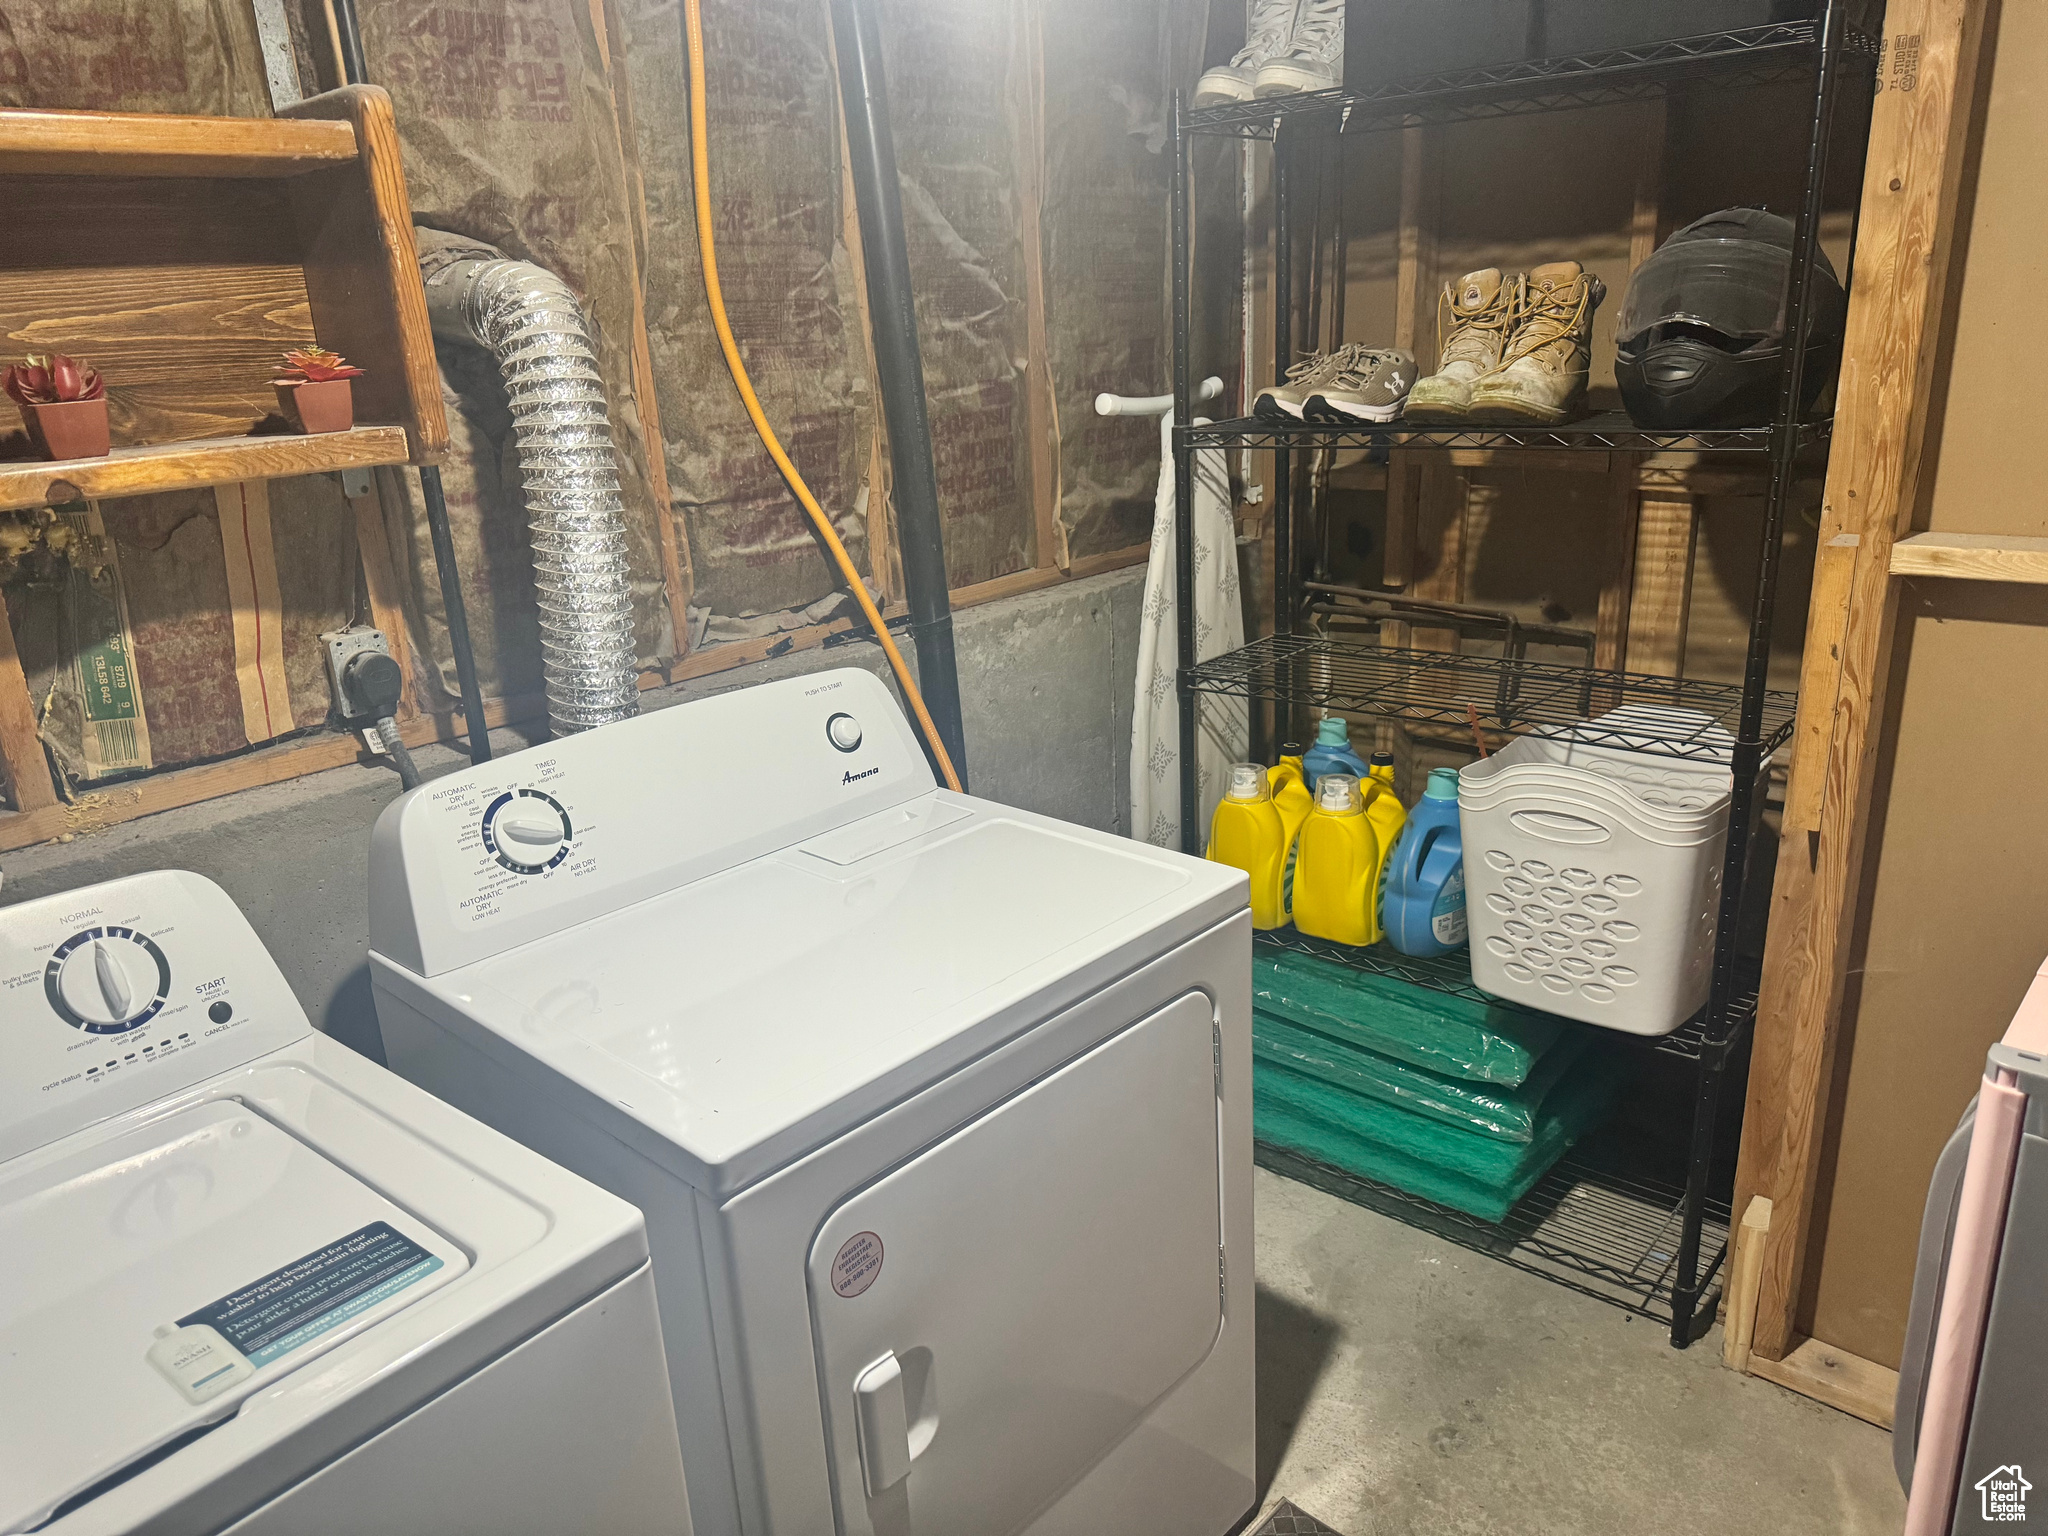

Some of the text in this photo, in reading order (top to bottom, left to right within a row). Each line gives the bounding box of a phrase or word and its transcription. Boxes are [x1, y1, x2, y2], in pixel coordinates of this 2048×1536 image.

[1893, 51, 1905, 75] STUD
[95, 655, 112, 704] 13L58 642
[114, 665, 127, 689] 87.19
[805, 688, 820, 696] PUSH
[827, 681, 843, 691] START
[535, 759, 557, 770] TIMED
[537, 771, 566, 785] HIGH HEAT
[541, 767, 556, 777] DRY
[842, 767, 879, 786] Amana
[432, 782, 477, 801] AUTOMATIC
[480, 786, 499, 795] wrinkle
[506, 782, 519, 790] OFF
[449, 794, 465, 804] DRY
[482, 790, 501, 800] prevent
[445, 798, 476, 813] HIGH HEAT
[469, 809, 484, 818] down
[472, 820, 481, 828] dry
[460, 829, 478, 838] energy
[574, 825, 597, 836] cool down
[457, 833, 480, 844] preferred
[460, 841, 483, 852] more dry
[572, 841, 584, 850] OFF
[479, 856, 492, 866] OFF
[570, 857, 597, 872] AIR DRY
[473, 864, 499, 876] cool down
[487, 869, 507, 880] less dry
[542, 871, 555, 880] OFF
[574, 865, 598, 878] NO HEAT
[478, 874, 518, 892] energy preferred
[506, 879, 528, 890] more dry
[459, 888, 504, 909] AUTOMATIC
[475, 900, 492, 912] DRY
[59, 907, 104, 925] NORMAL
[120, 914, 141, 926] casual
[471, 906, 501, 922] LOW HEAT
[73, 919, 96, 931] regular
[150, 926, 175, 938] delicate
[33, 942, 54, 952] heavy
[2, 969, 42, 986] bulky items
[16, 976, 40, 987] sheets
[195, 976, 226, 994] START
[201, 993, 222, 1003] UNLOCK
[158, 1004, 189, 1018] rinse/spin
[110, 1024, 151, 1043] clean washer
[204, 1024, 231, 1037] CANCEL
[66, 1036, 100, 1052] drain/spin
[117, 1038, 130, 1046] with
[160, 1044, 173, 1052] cycle
[180, 1040, 197, 1050] locked
[158, 1047, 180, 1059] complete
[126, 1058, 139, 1066] rinse
[107, 1065, 121, 1073] wash
[41, 1072, 82, 1092] cycle status
[85, 1071, 106, 1082] sensing
[841, 1238, 866, 1260] REGISTER
[838, 1241, 873, 1271] ENREGISTRER
[845, 1252, 871, 1275] REGISTRE
[217, 1232, 389, 1320] washer to help boost stain fighting
[226, 1233, 366, 1307] Detergent designed for your
[283, 1285, 316, 1303] conçu
[316, 1271, 341, 1288] pour
[341, 1257, 368, 1273] votre
[367, 1239, 404, 1260] laveuse
[235, 1321, 263, 1340] pour
[264, 1306, 291, 1324] aider
[299, 1286, 329, 1304] lutter
[330, 1270, 363, 1289] contre
[362, 1261, 378, 1271] les
[260, 1343, 278, 1357] GET
[278, 1329, 304, 1346] YOUR
[304, 1315, 332, 1333] OFFER
[332, 1310, 343, 1319] AT
[343, 1261, 431, 1312] SWASH.COM/SAVENOW
[173, 1344, 211, 1366] SWASH
